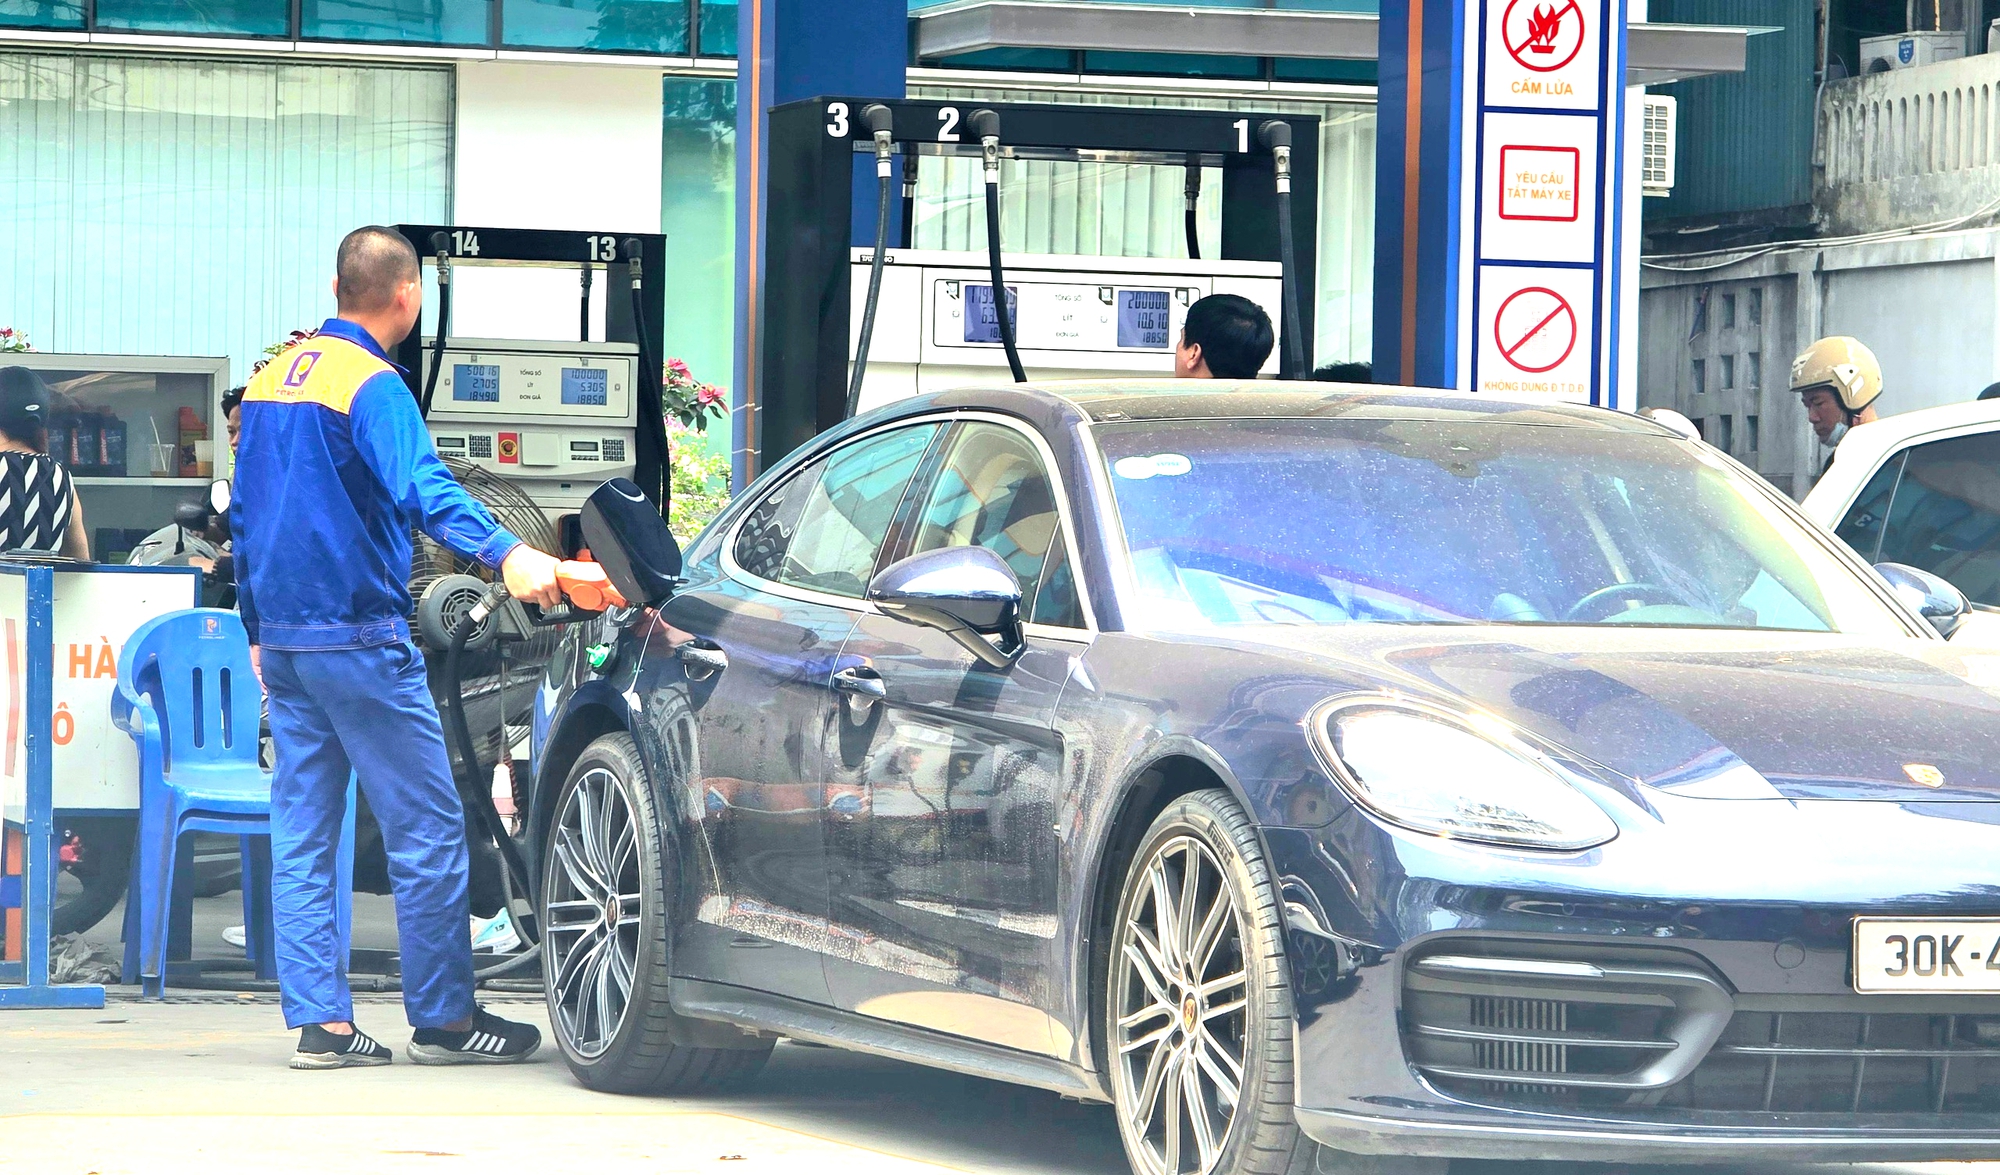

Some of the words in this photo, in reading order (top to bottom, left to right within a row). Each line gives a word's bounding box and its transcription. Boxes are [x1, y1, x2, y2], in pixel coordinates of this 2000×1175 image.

[1511, 77, 1542, 94] CẤM
[1546, 79, 1573, 95] LỬA
[827, 102, 849, 138] 3
[937, 107, 960, 142] 2
[1233, 119, 1249, 153] 1
[1516, 170, 1538, 183] YÊU
[1557, 190, 1572, 200] XE
[452, 230, 480, 256] 14
[587, 236, 616, 261] 13
[1128, 292, 1167, 309] 200000
[572, 369, 604, 380] 100000
[1484, 380, 1519, 391] KHÔNG
[69, 636, 125, 679] HÀ
[1207, 820, 1234, 867] PIRELLI
[1885, 935, 2000, 976] 30K-4
